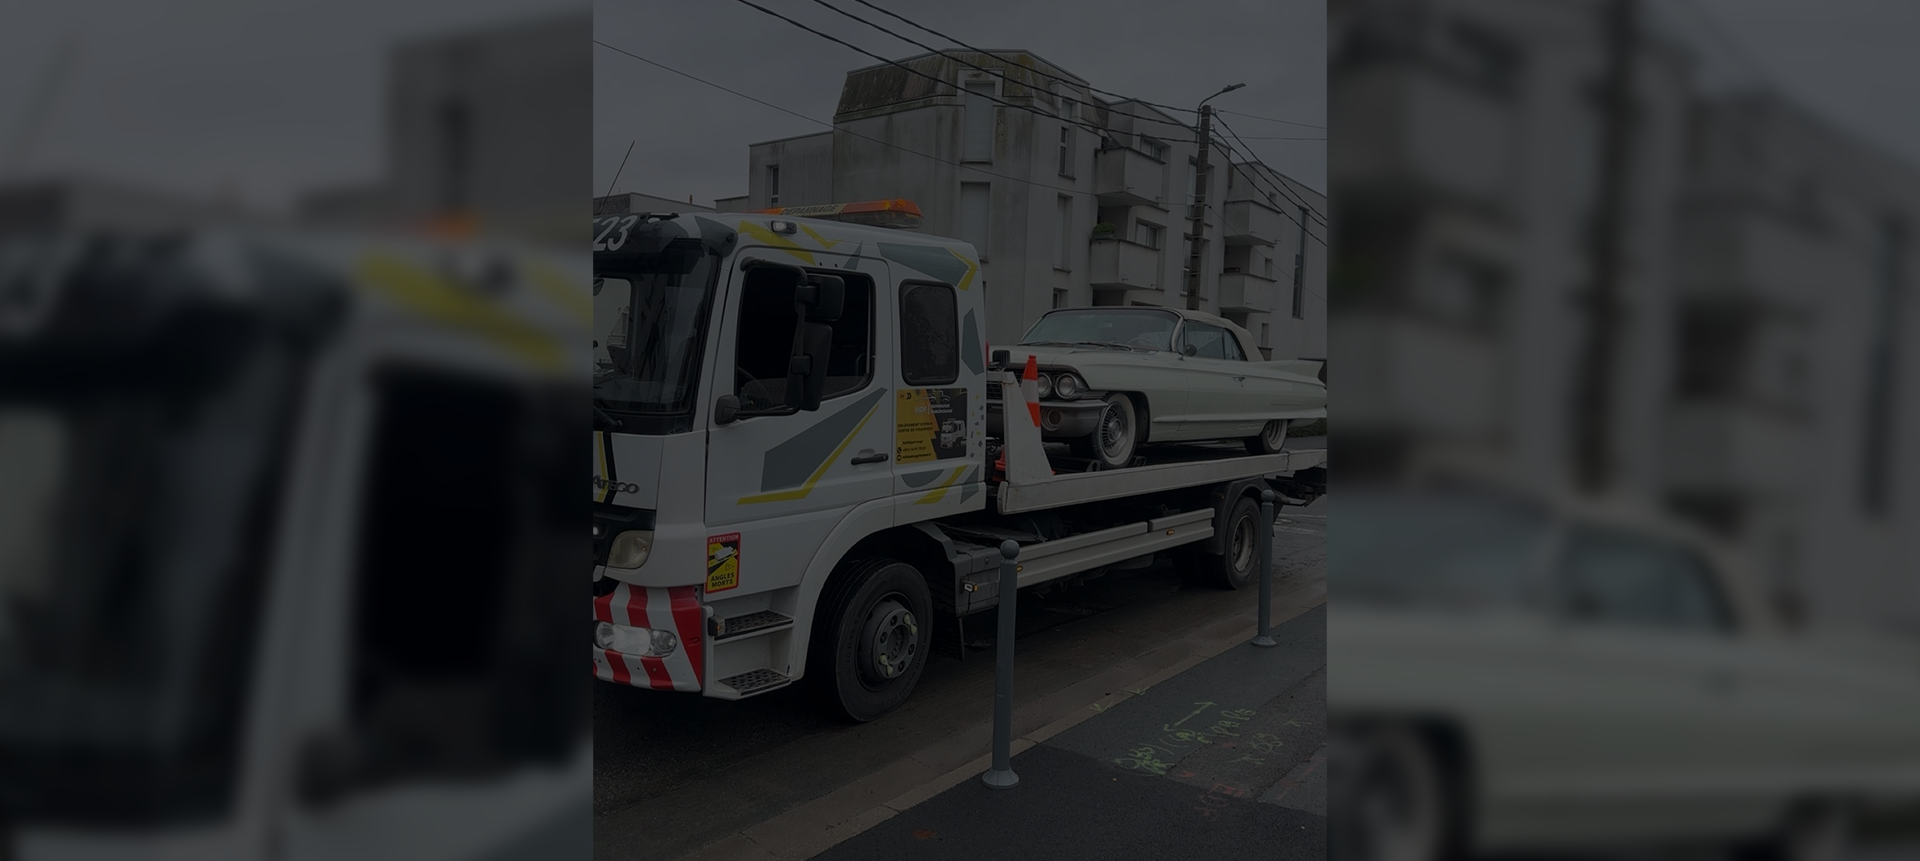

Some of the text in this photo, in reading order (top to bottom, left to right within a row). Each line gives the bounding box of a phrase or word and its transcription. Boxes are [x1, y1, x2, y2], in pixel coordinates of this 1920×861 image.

[780, 204, 840, 215] DEPANNAGE
[593, 215, 638, 252] 23
[915, 406, 928, 414] HDF
[708, 533, 739, 543] ATTENTION
[710, 572, 735, 582] ANGLES
[711, 578, 734, 588] MORTS
